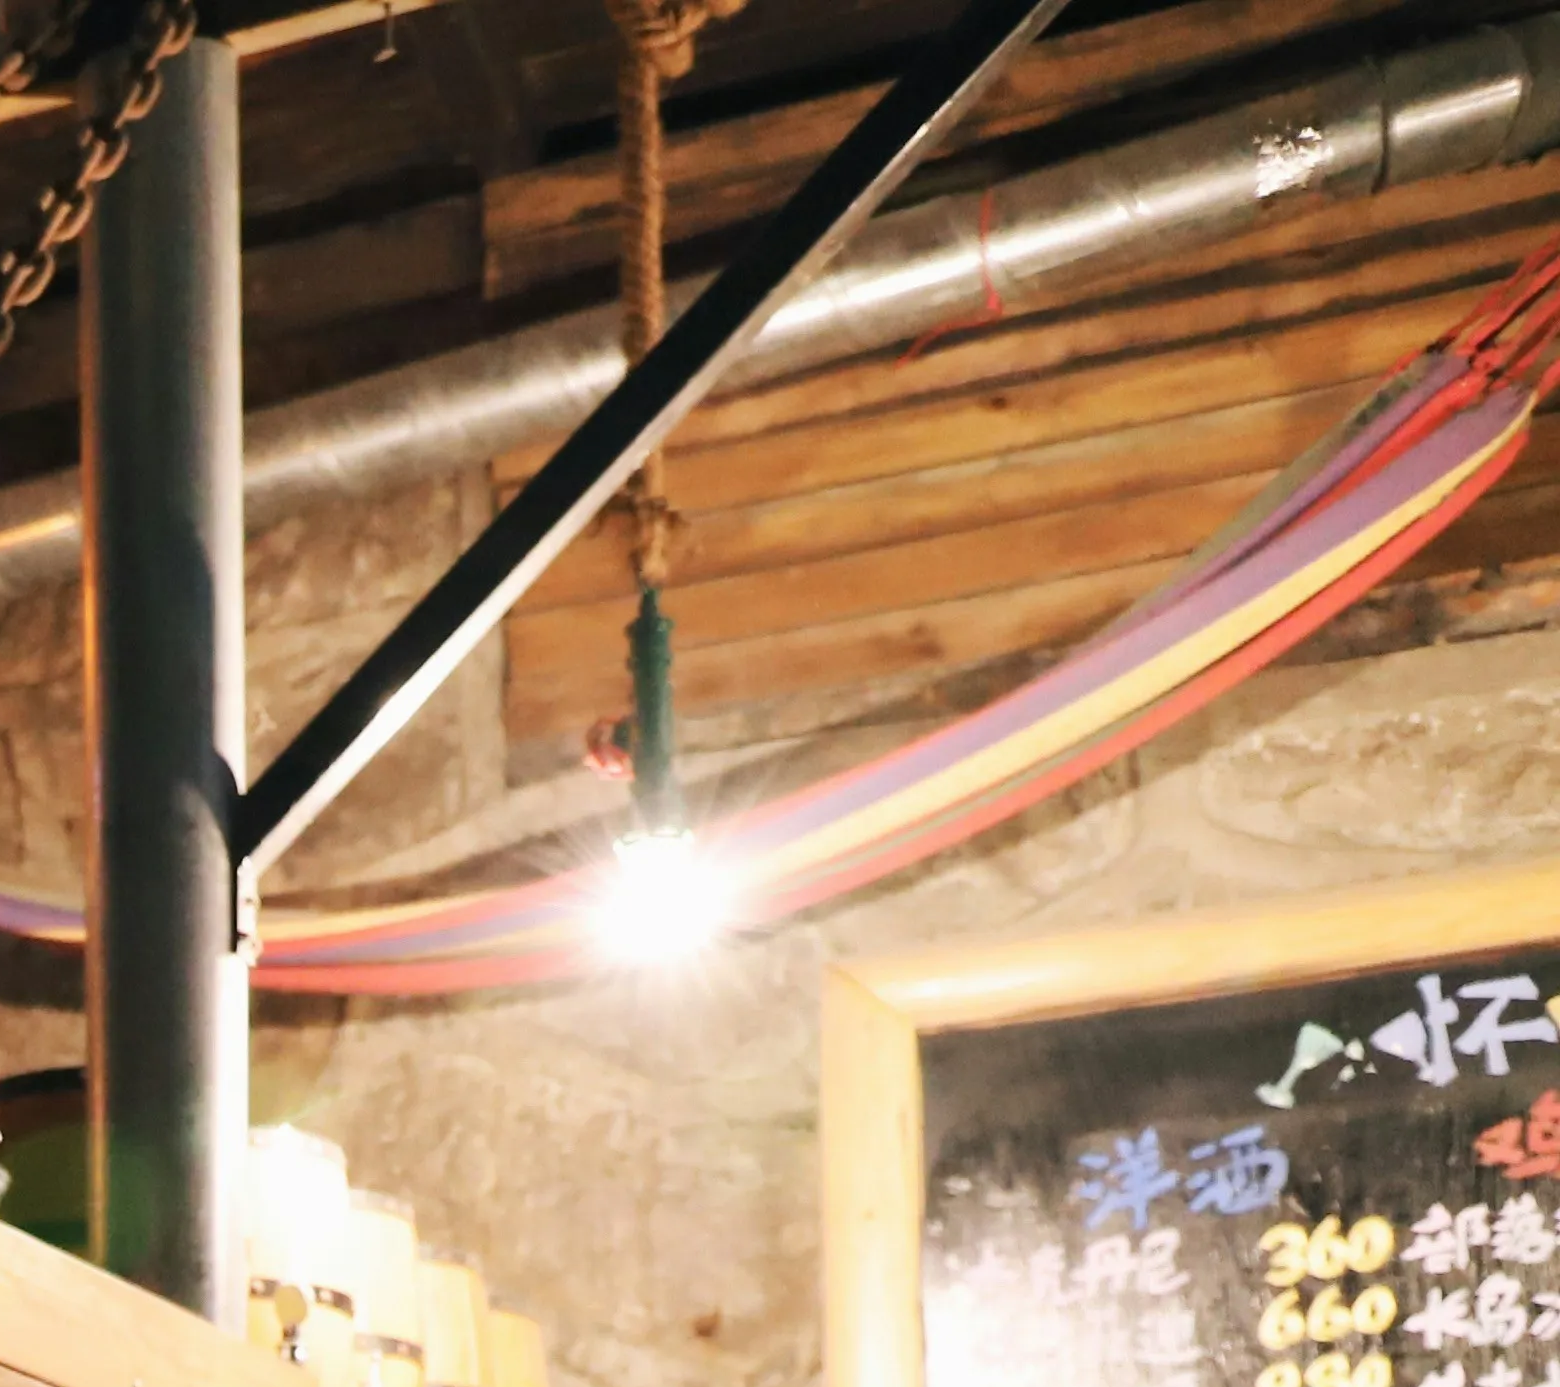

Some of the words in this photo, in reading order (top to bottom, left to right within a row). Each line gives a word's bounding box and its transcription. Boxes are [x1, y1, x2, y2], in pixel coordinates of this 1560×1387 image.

[1076, 1125, 1290, 1229] 洋酒
[1258, 1213, 1396, 1287] 360
[1400, 1192, 1560, 1275] 部落
[1257, 1284, 1398, 1352] 660
